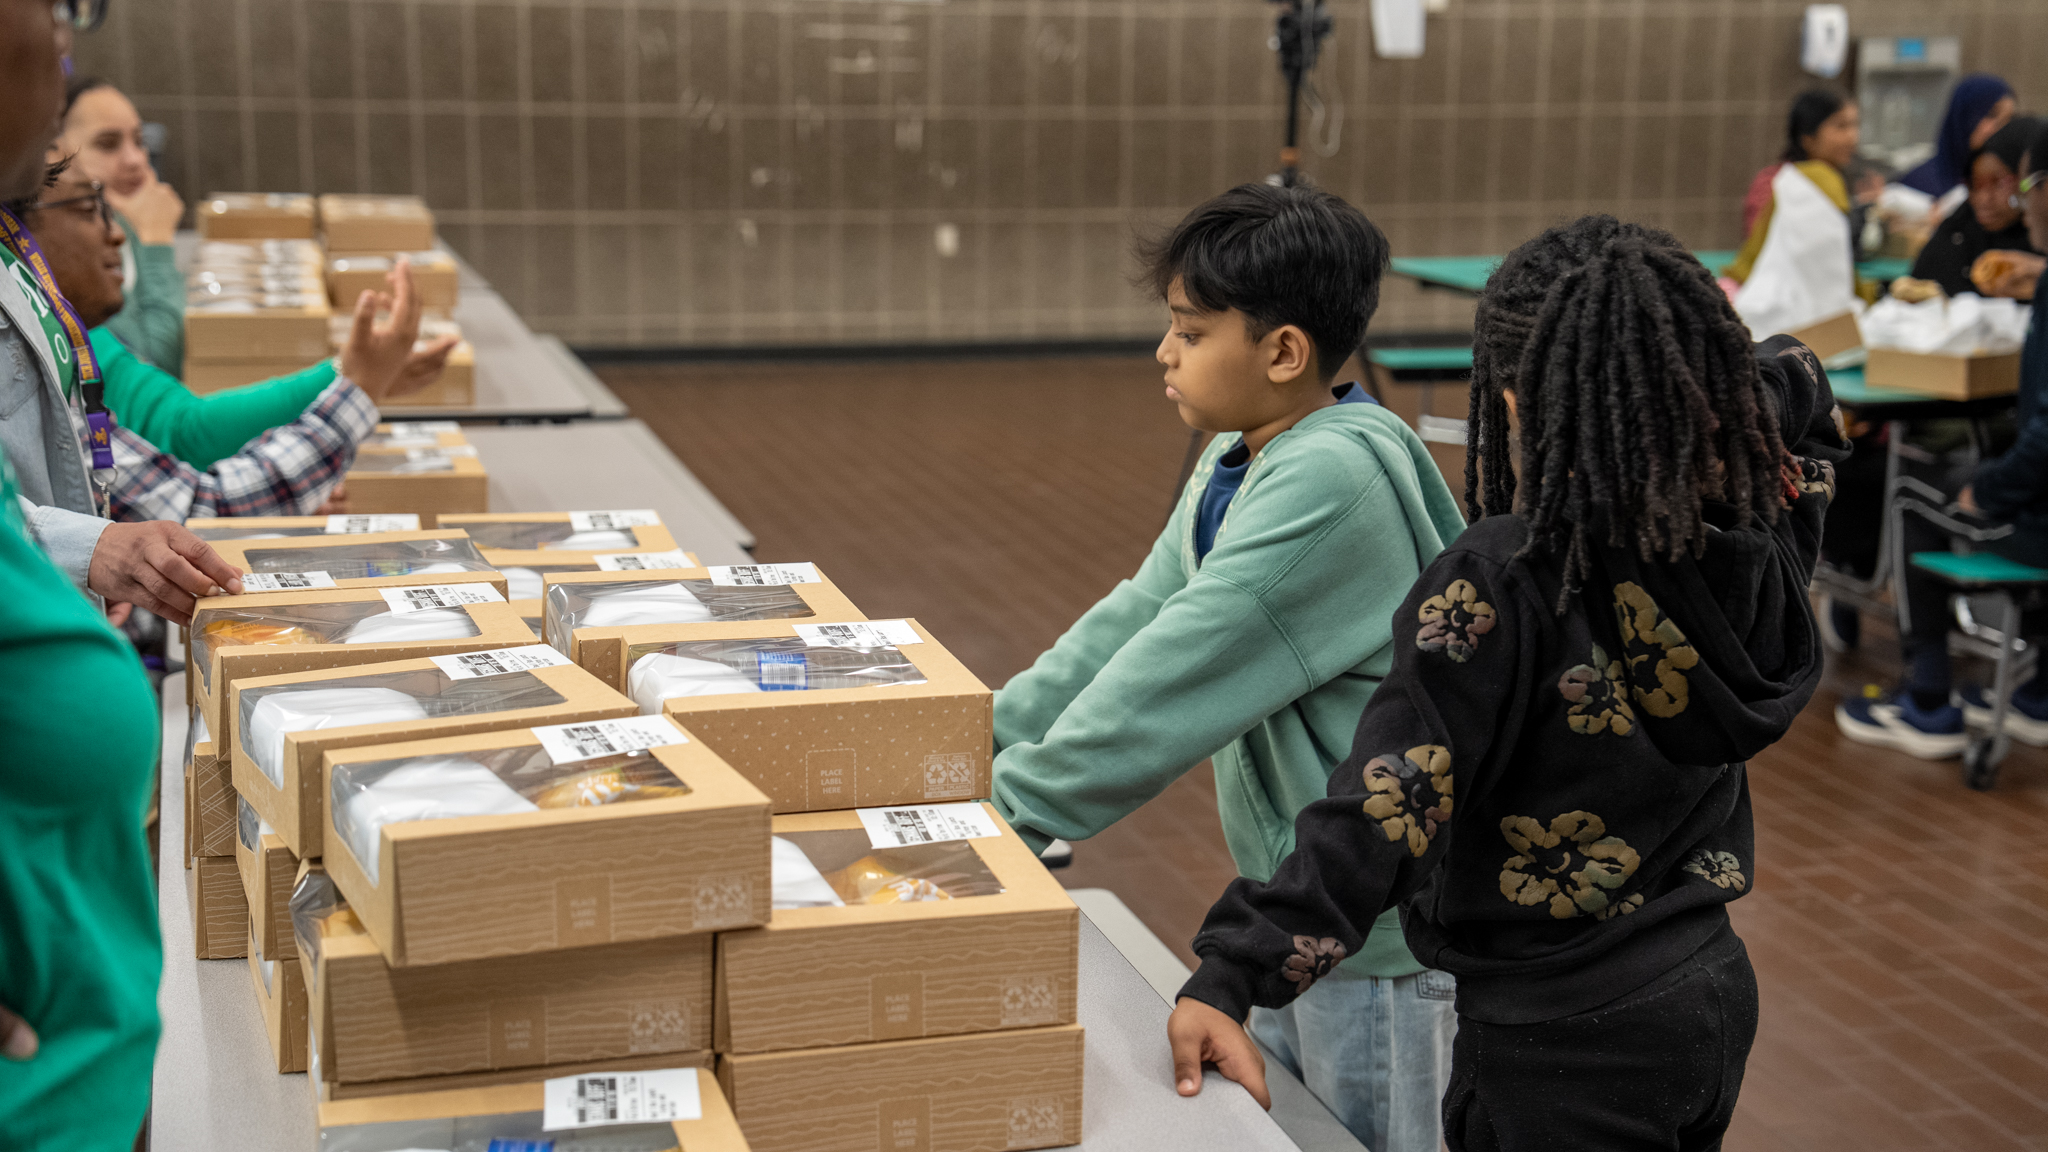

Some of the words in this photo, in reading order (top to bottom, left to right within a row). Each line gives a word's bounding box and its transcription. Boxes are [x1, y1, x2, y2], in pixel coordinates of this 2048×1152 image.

[820, 768, 843, 777] PLACE
[821, 778, 843, 786] LABEL
[822, 786, 842, 794] HERE
